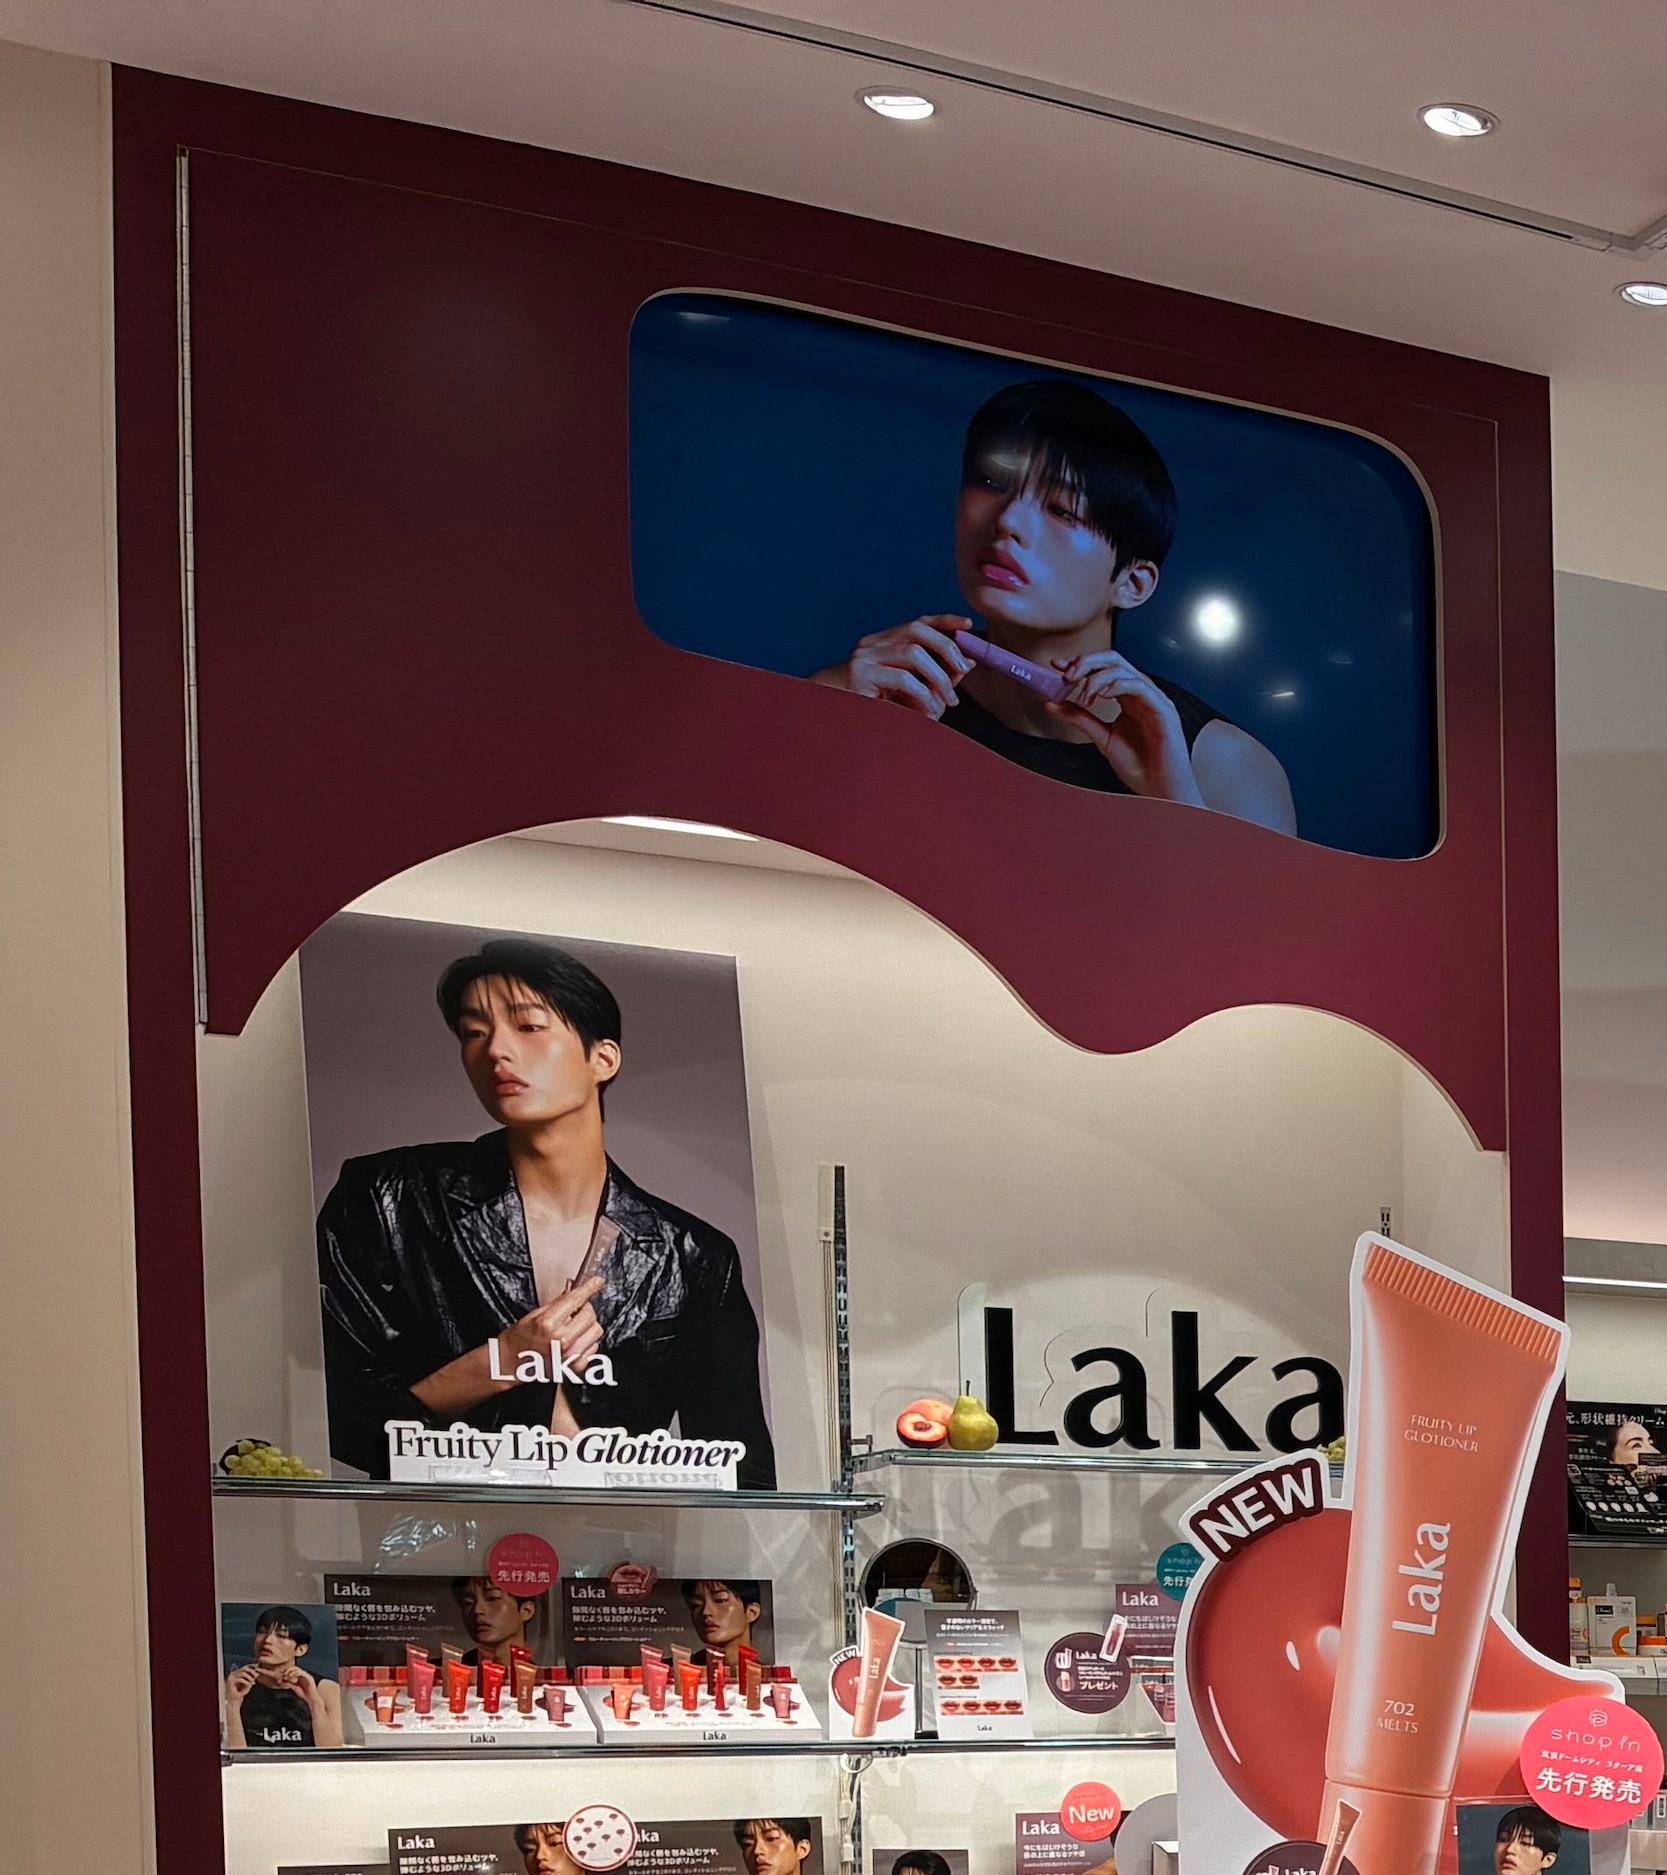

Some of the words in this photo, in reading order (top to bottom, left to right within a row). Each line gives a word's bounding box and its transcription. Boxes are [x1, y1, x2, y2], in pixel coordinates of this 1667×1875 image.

[487, 1337, 617, 1387] Laka
[983, 1307, 1345, 1455] Laka
[1411, 1414, 1453, 1431] FRUITY
[392, 1425, 502, 1467] Fruity
[510, 1426, 566, 1472] Lip
[576, 1432, 740, 1469] Glotioner
[1404, 1429, 1479, 1452] GLOTIONER
[1199, 1467, 1316, 1553] NEW
[1392, 1522, 1450, 1635] Laka
[333, 1582, 371, 1597] Laka
[571, 1586, 606, 1599] Laka
[1122, 1591, 1159, 1606] Laka
[834, 1650, 857, 1665] NEW
[1076, 1651, 1097, 1660] Laka
[1384, 1700, 1415, 1716] 702
[263, 1726, 302, 1741] Laka
[470, 1733, 495, 1743] Laka
[703, 1731, 726, 1741] Laka
[1551, 1728, 1613, 1751] shop
[1620, 1735, 1640, 1752] in
[1535, 1767, 1641, 1804] 先行発売
[1069, 1805, 1114, 1824] New
[1022, 1820, 1060, 1835] Laka
[397, 1834, 435, 1850] Laka
